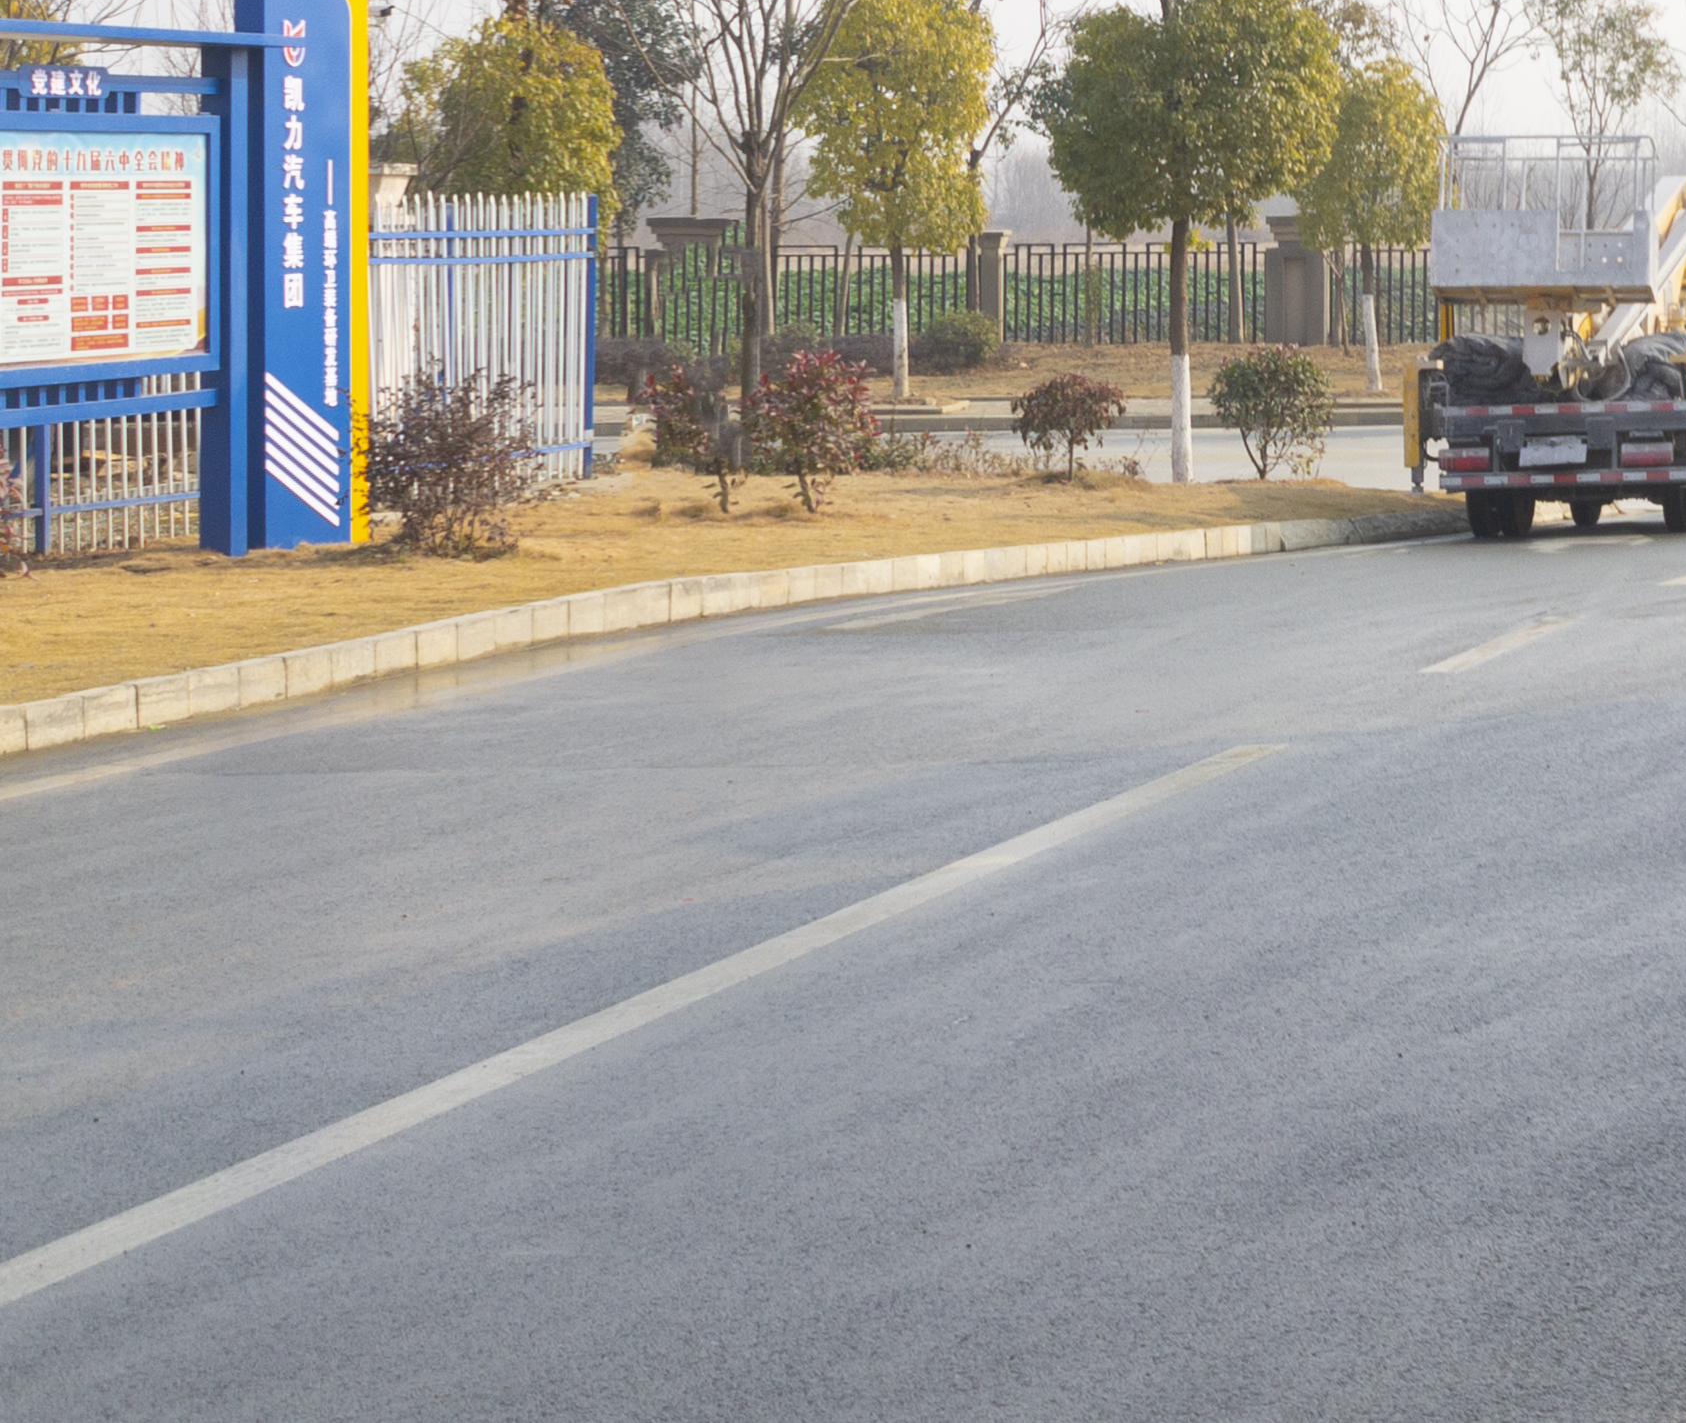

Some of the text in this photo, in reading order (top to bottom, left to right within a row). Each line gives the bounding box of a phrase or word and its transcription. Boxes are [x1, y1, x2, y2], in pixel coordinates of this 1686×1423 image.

[31, 68, 102, 96] 党建文化
[282, 75, 305, 308] 凯力汽车集团
